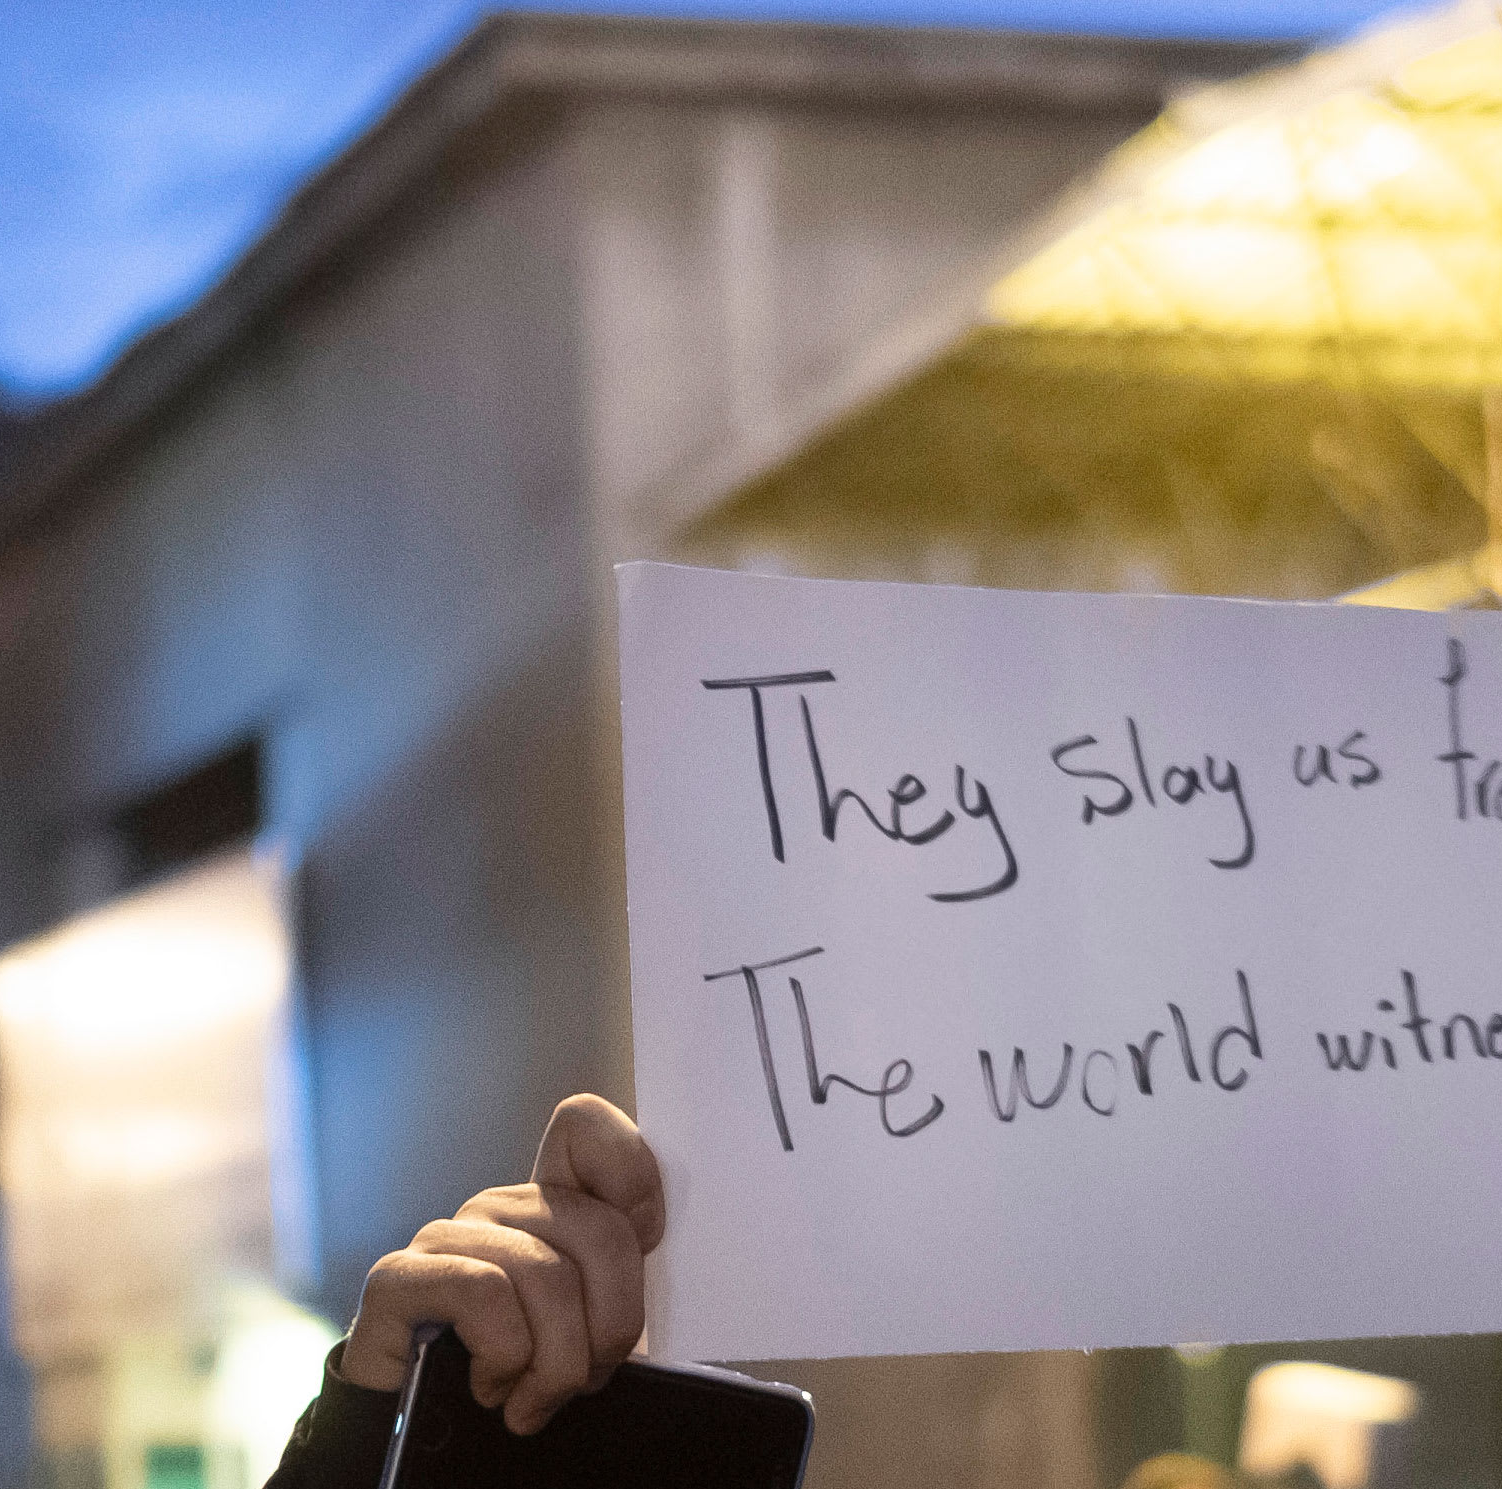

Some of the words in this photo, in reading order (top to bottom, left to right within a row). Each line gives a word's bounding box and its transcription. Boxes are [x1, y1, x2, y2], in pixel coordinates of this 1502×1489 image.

[701, 669, 1020, 904] They
[1050, 717, 1256, 871] slay
[1293, 730, 1382, 789] us
[703, 946, 945, 1153] The
[978, 969, 1263, 1123] world
